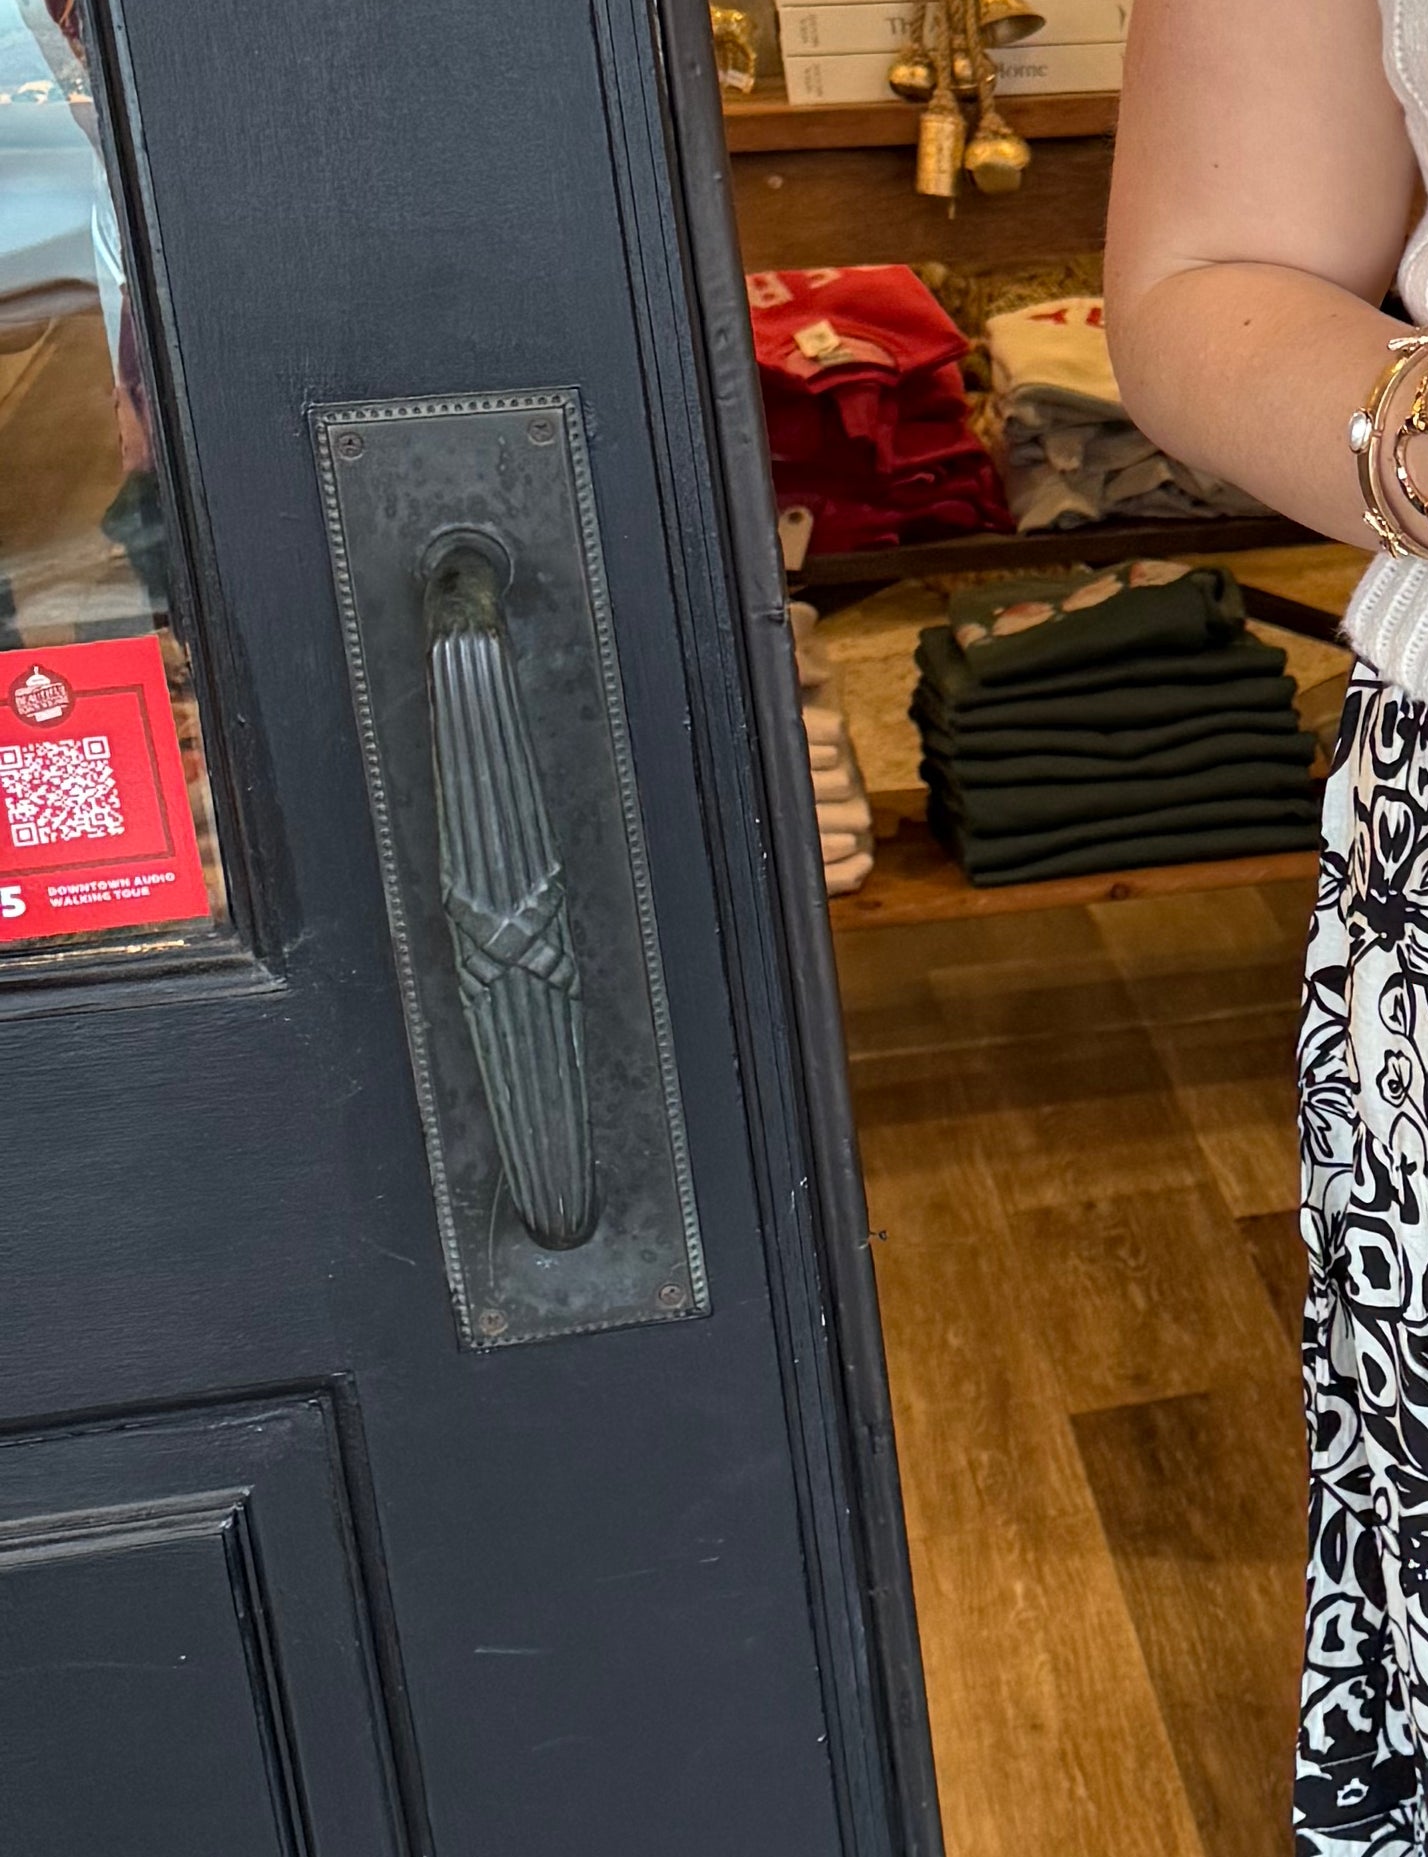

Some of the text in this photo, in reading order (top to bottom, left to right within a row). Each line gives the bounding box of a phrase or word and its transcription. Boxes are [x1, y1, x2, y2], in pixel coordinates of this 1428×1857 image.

[47, 872, 176, 897] DOWNTOWN AUDIO
[50, 886, 151, 908] WALKING TOUR
